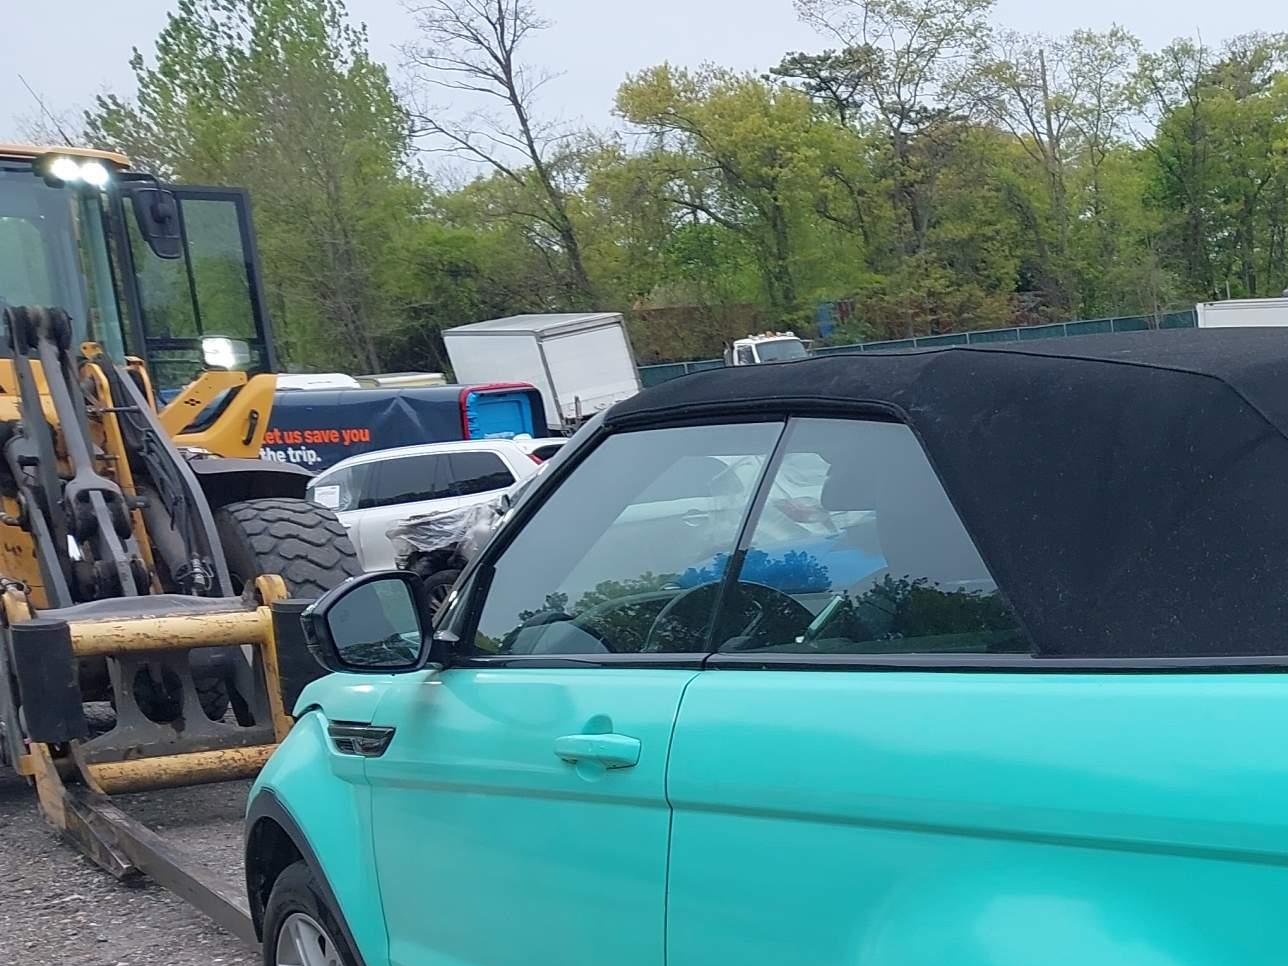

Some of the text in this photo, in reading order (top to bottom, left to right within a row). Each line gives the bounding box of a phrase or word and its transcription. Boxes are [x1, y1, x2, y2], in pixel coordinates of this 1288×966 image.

[262, 428, 370, 446] et us save you
[260, 445, 322, 466] the trip.
